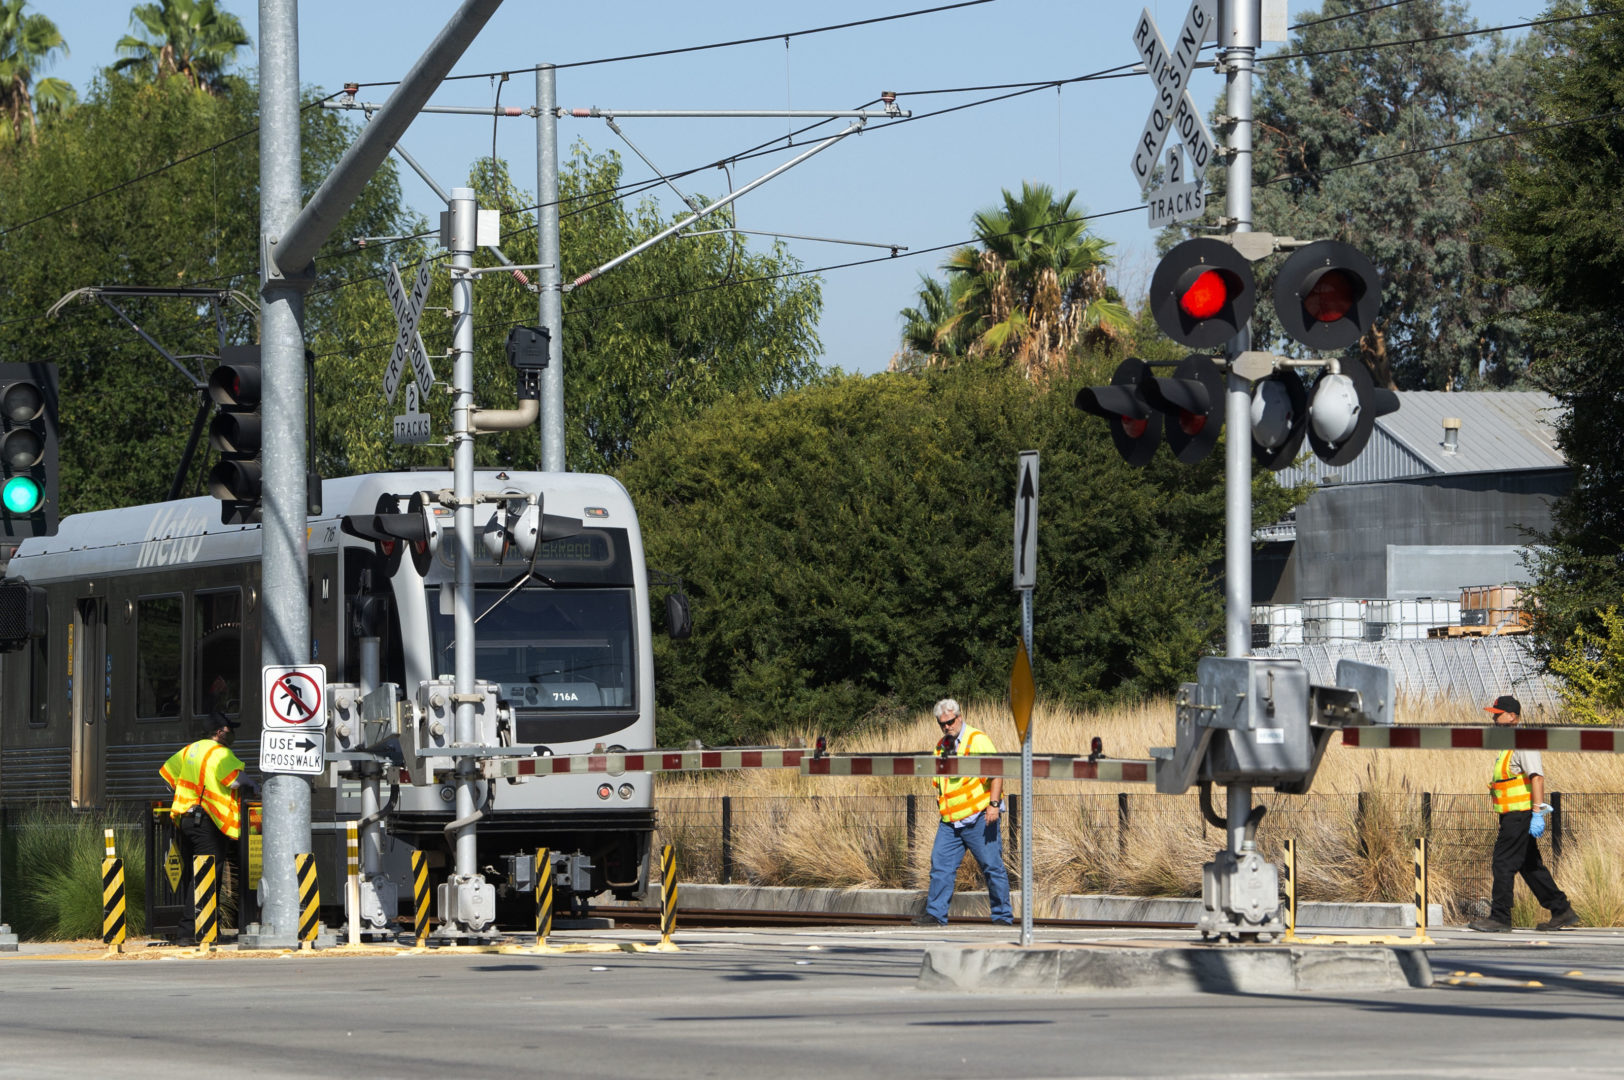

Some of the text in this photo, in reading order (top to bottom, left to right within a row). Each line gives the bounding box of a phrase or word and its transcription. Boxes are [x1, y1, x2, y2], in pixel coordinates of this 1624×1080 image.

[1135, 4, 1205, 178] CROSSING
[1170, 156, 1180, 183] 2
[1150, 189, 1203, 222] TRACKS
[385, 267, 428, 395] CROSSING
[408, 391, 415, 412] 2
[395, 420, 429, 438] TRACKS
[135, 506, 208, 569] Metro
[323, 526, 337, 543] 716
[322, 578, 329, 599] M
[552, 692, 579, 701] 716A
[269, 737, 294, 750] USE
[264, 753, 321, 768] CROSSWALK
